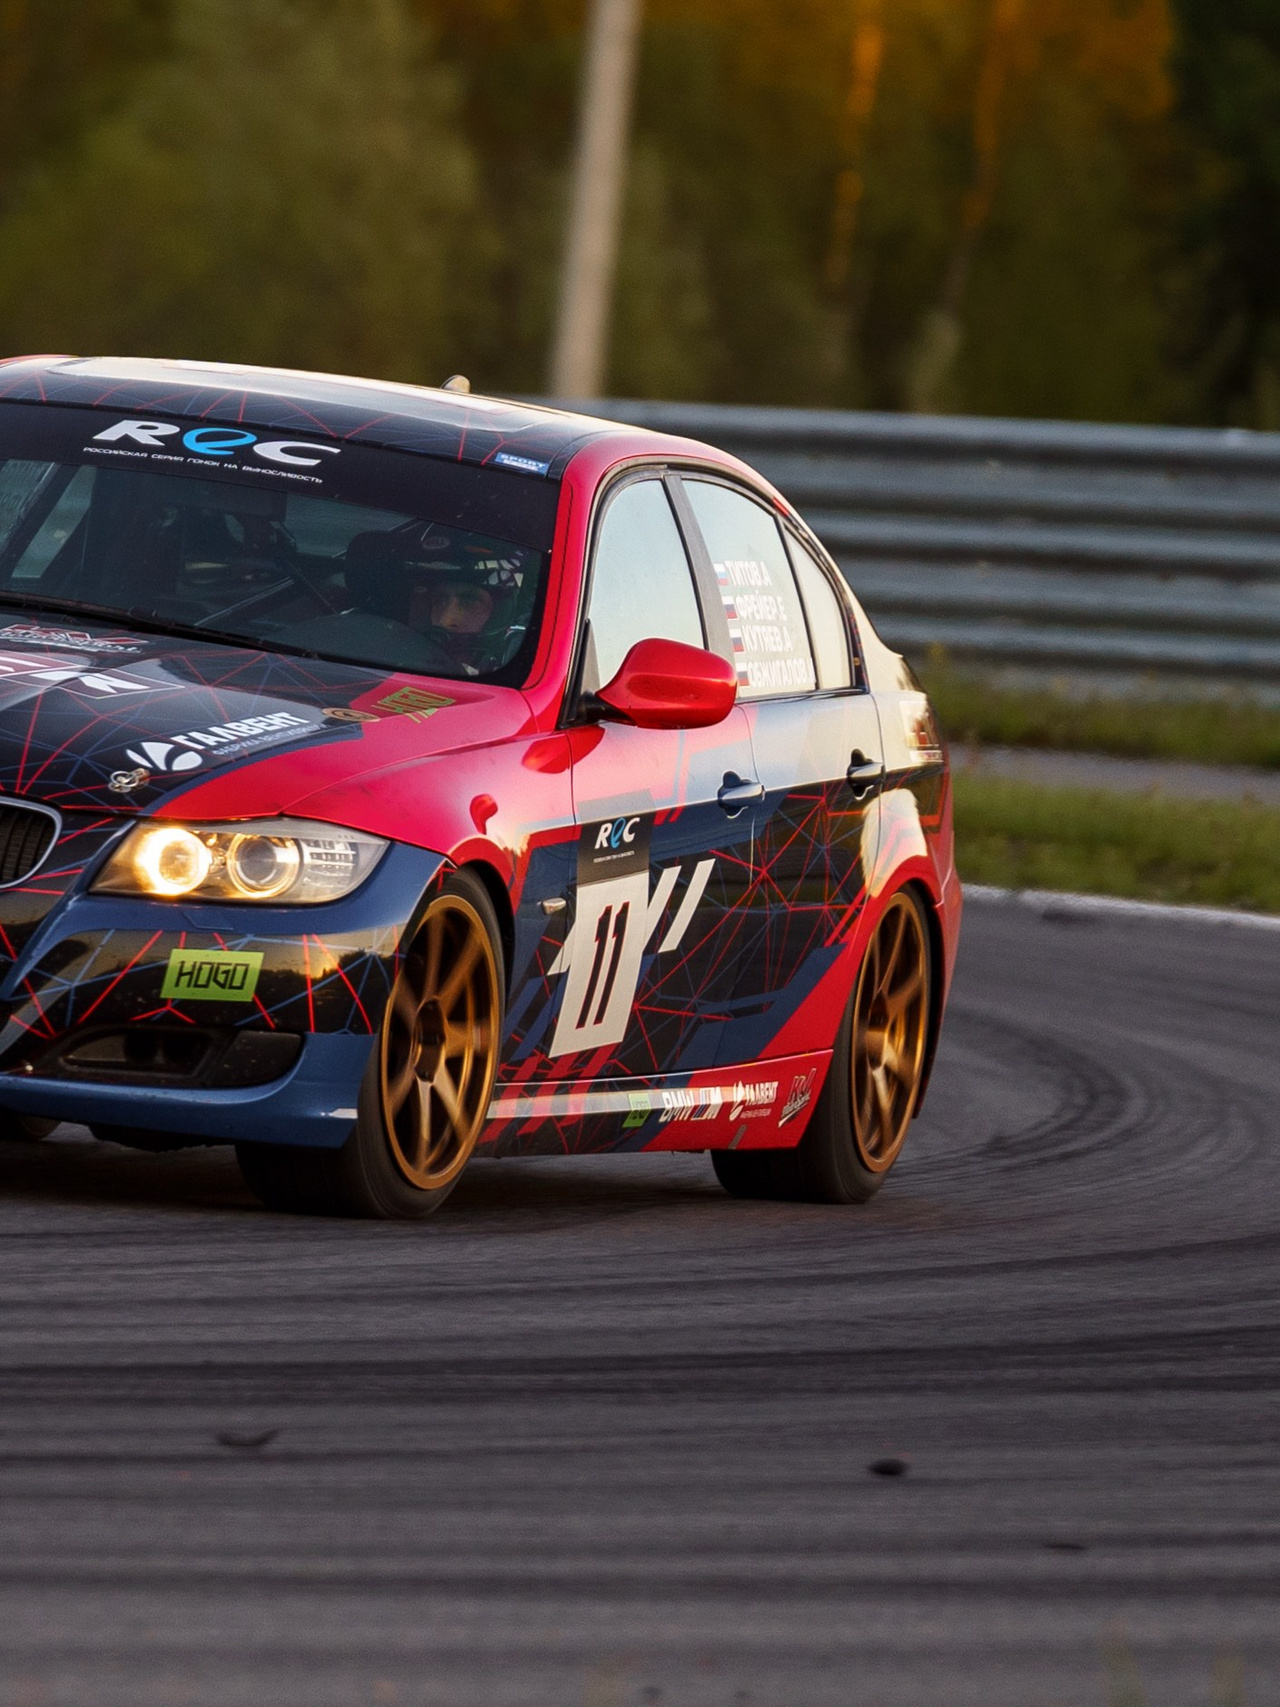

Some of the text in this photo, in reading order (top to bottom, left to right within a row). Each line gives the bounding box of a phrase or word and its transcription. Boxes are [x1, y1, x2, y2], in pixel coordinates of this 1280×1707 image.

[83, 447, 148, 458] РОССИЙСКАЯ
[151, 453, 184, 462] СЕРИЯ
[187, 458, 220, 467] ГОНОК
[242, 465, 323, 484] ВЫНОСЛИВОСТЬ
[174, 961, 250, 990] HOGO
[575, 901, 630, 1029] 11
[658, 1089, 695, 1123] BMW
